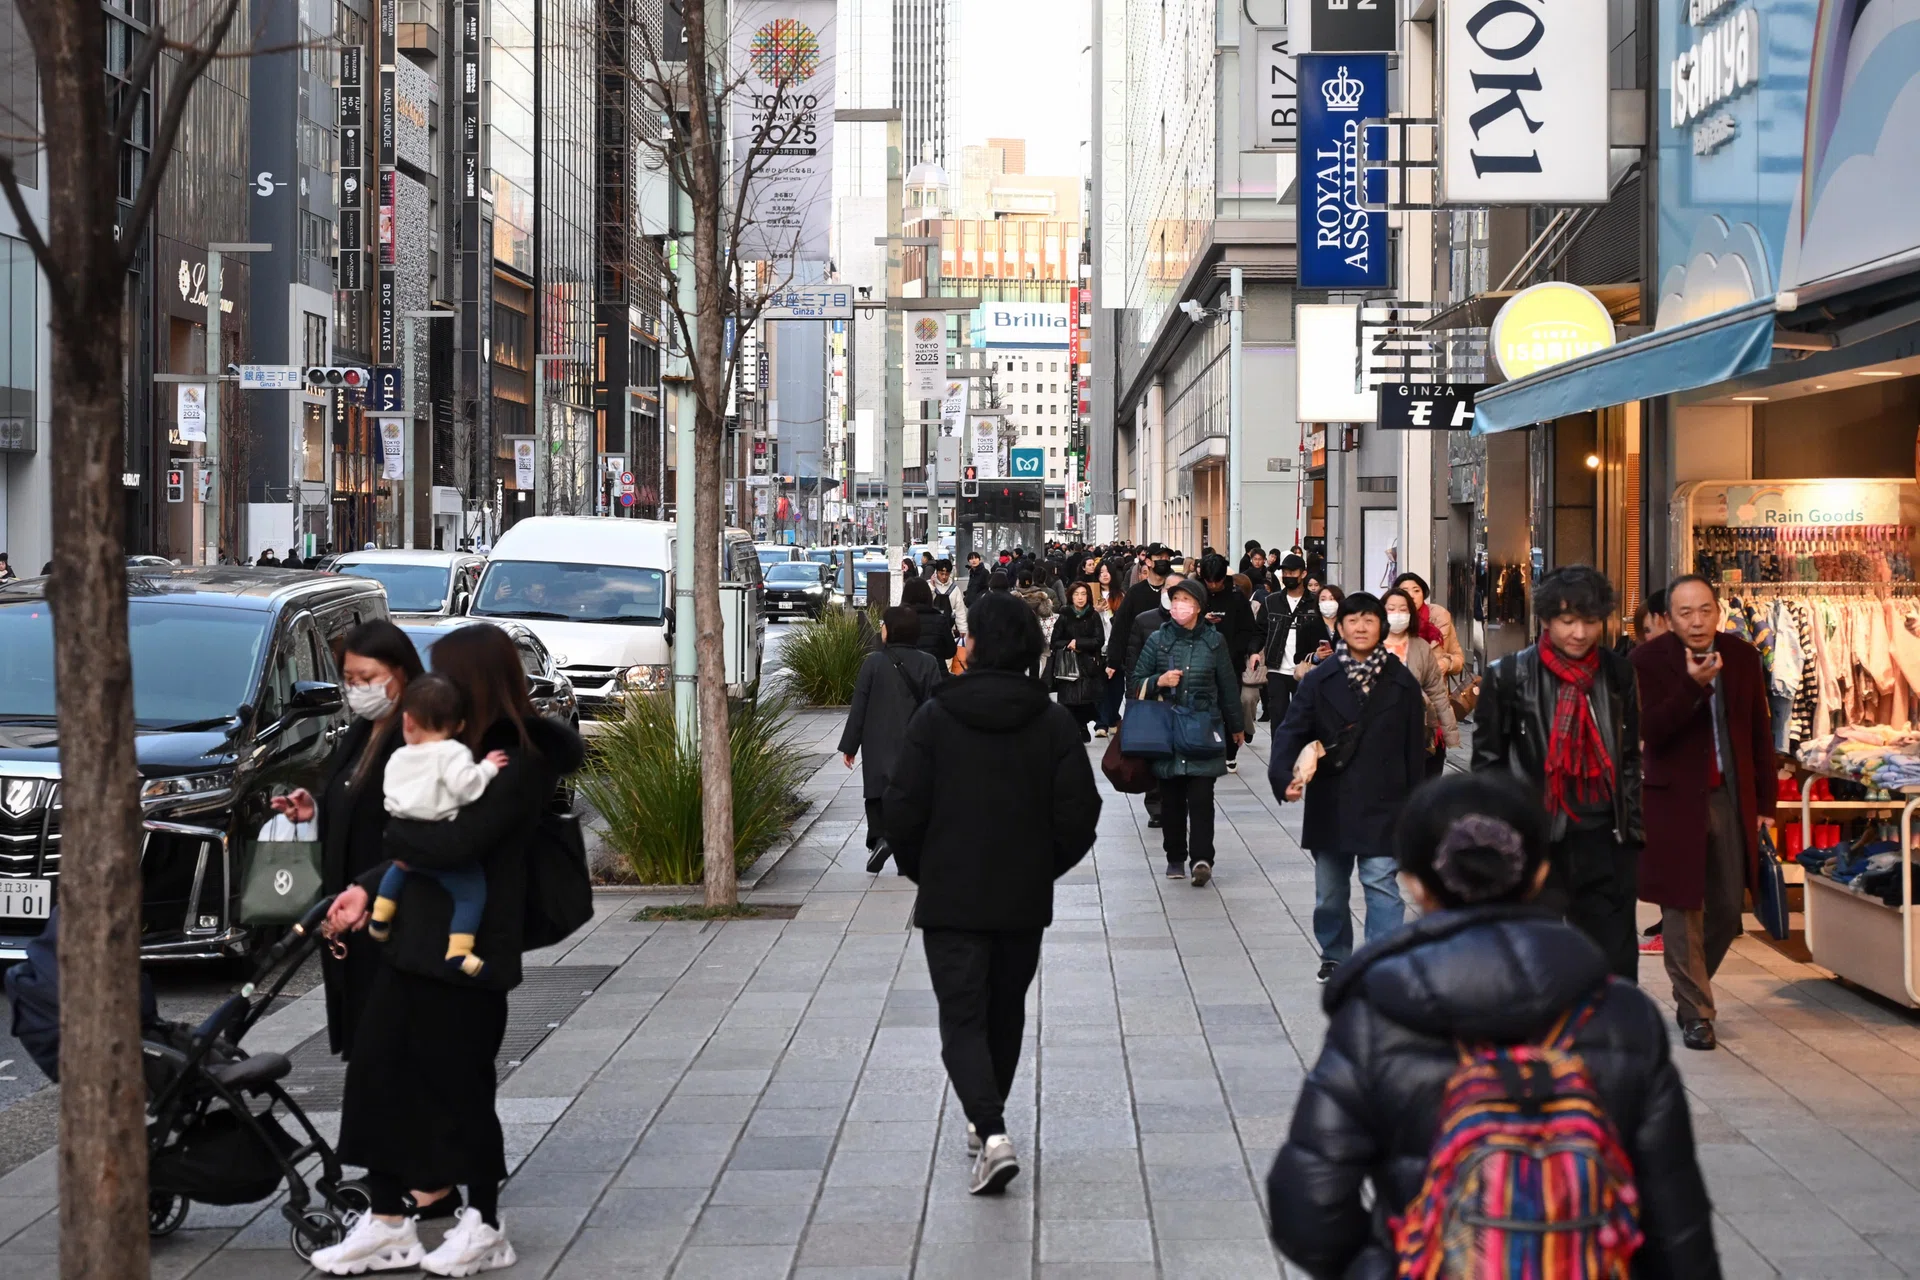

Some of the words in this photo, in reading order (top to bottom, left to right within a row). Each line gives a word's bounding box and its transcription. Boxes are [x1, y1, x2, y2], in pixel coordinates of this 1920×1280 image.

[383, 88, 392, 113] NAILS
[751, 94, 817, 110] TOKYO
[751, 112, 817, 122] MARATHON
[383, 114, 392, 148] UNIQUE
[467, 116, 476, 139] Zina
[751, 124, 817, 145] 2025
[256, 171, 275, 197] S
[1316, 138, 1343, 250] ROYAL
[382, 283, 391, 305] BDC
[770, 293, 847, 307] 銀座三丁目
[792, 307, 815, 316] Ginza
[817, 307, 823, 315] 3
[994, 312, 1068, 328] Brillia
[382, 310, 391, 351] PILATES
[915, 353, 939, 361] 2025
[243, 371, 298, 381] 銀座三丁目
[1398, 385, 1455, 396] GINZA
[1765, 509, 1804, 523] Rain
[1808, 509, 1864, 522] Goods
[15, 882, 32, 893] 331
